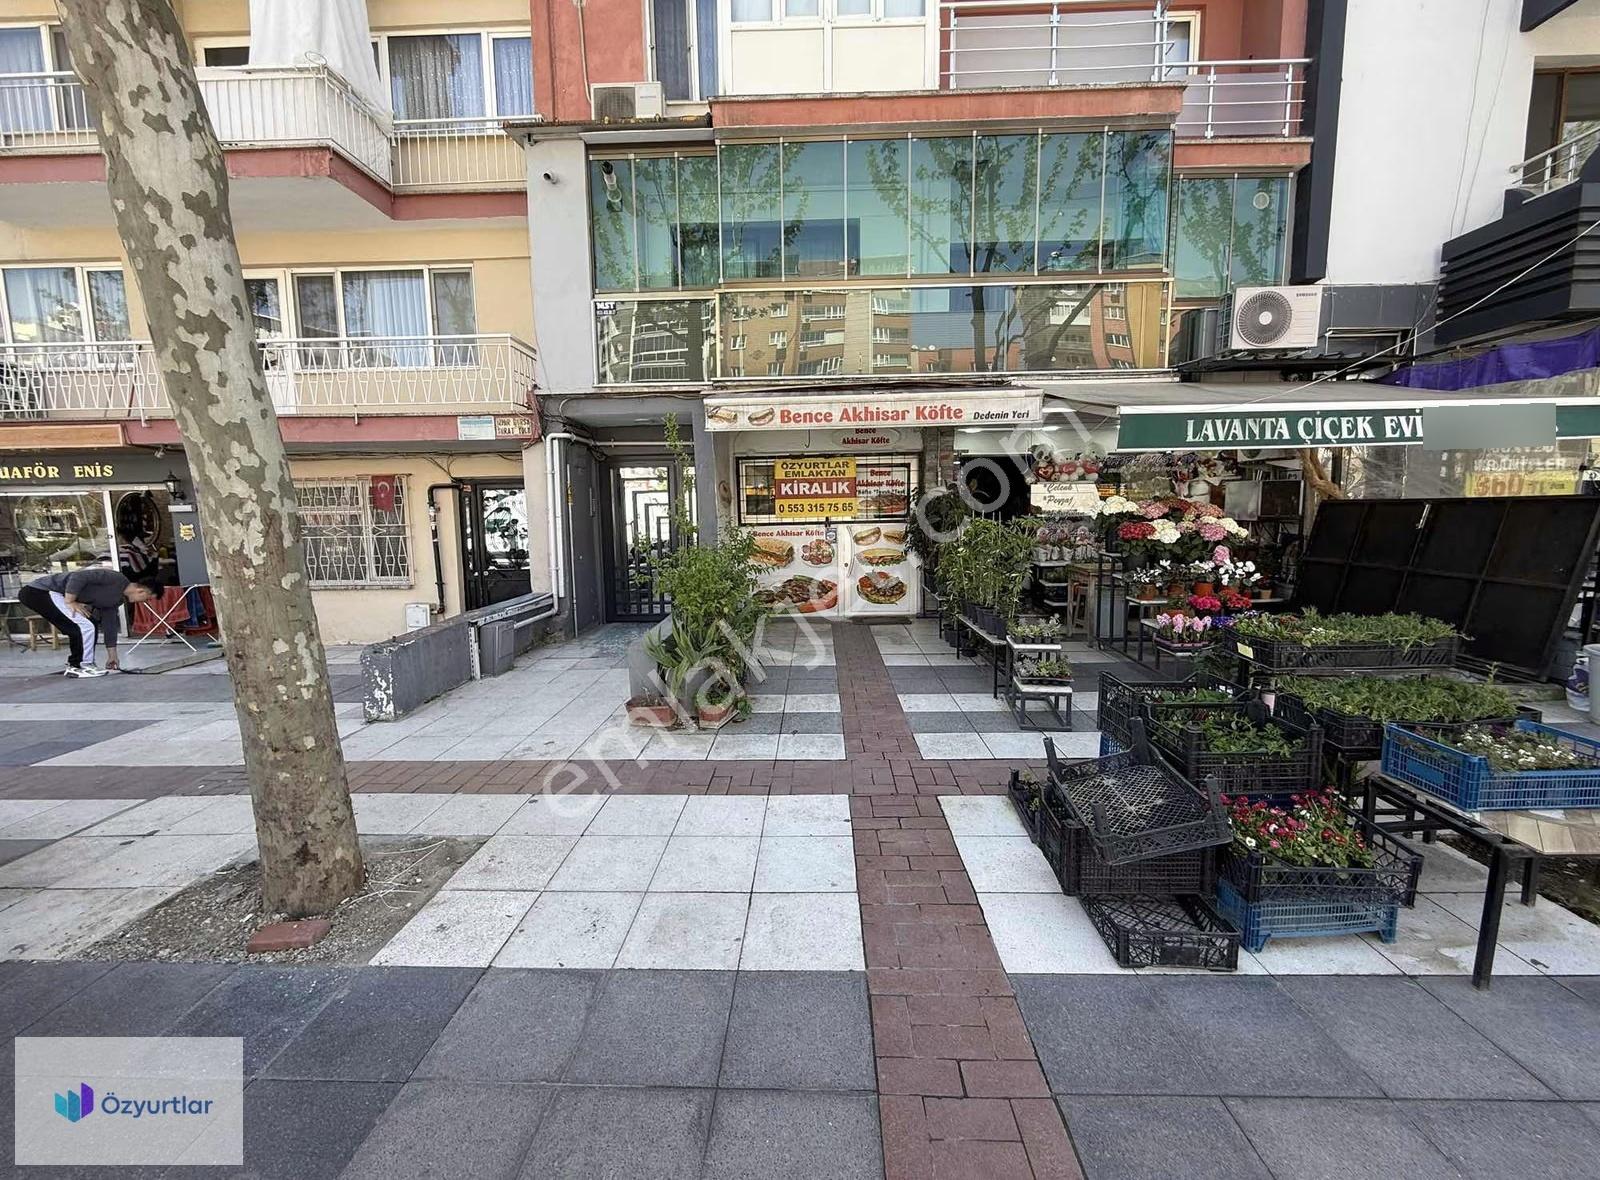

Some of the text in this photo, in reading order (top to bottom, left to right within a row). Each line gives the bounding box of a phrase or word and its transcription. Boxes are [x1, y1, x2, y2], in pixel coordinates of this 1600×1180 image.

[780, 404, 964, 424] Bence Akhisar Köfte
[973, 410, 1030, 420] Dedenin Yeri
[1186, 416, 1290, 442] LAVANTA
[1297, 410, 1376, 445] ÇİÇEK
[842, 435, 890, 445] Akhisar Köfte
[73, 462, 114, 478] ENİS
[781, 460, 850, 470] ÖZYURTLAR
[784, 469, 846, 478] EMLAKTAN
[780, 480, 850, 496] KİRALIK
[779, 502, 854, 513] 0 553 315 75 65
[776, 529, 803, 537] Akhisar
